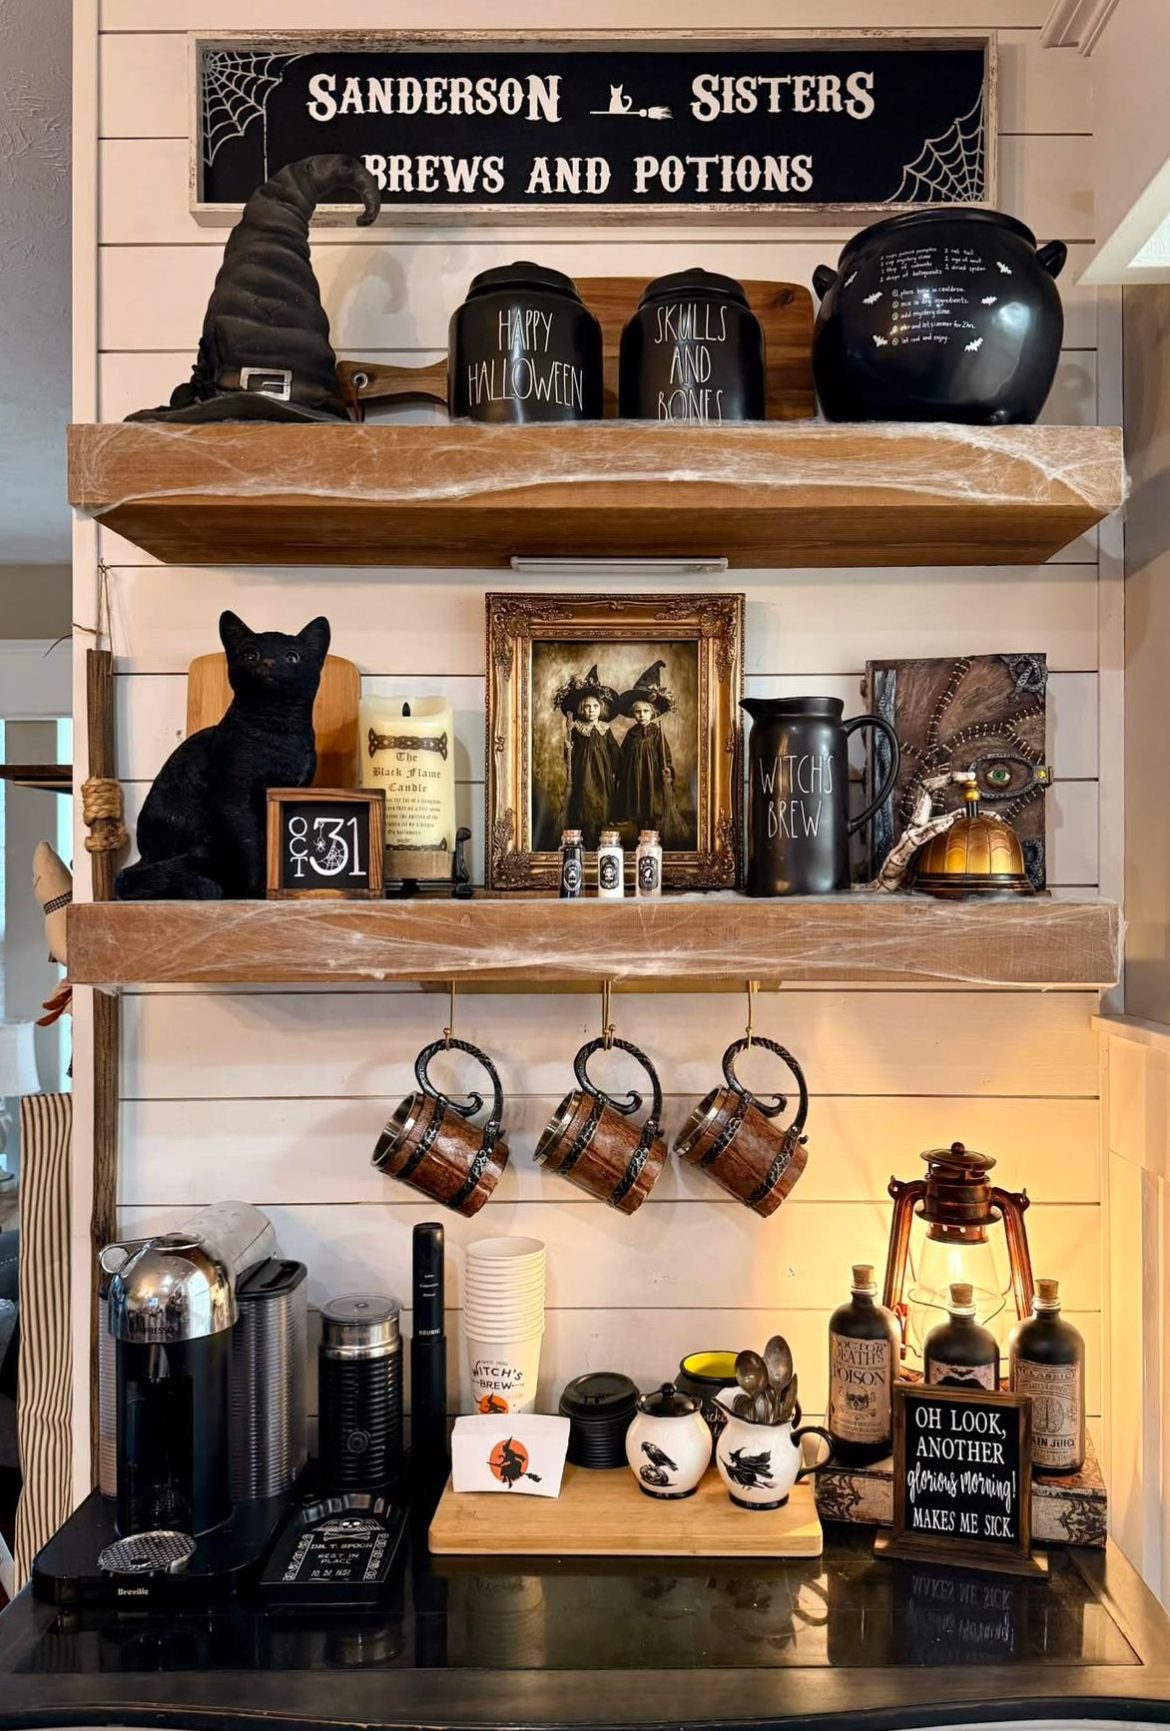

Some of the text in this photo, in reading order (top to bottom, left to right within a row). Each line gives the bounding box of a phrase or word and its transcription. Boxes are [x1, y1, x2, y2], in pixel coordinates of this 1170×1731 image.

[305, 72, 875, 123] SANDERSON SISTERS
[361, 154, 814, 194] BREWS AND POTIONS
[498, 309, 553, 353] HAPPY
[654, 303, 728, 344] SKULLS
[669, 344, 712, 386] AND
[468, 357, 583, 412] HALLOWEEN
[657, 389, 723, 426] BONES
[372, 766, 441, 779] Black Flame
[395, 751, 418, 763] The
[388, 781, 428, 793] Candle
[767, 800, 822, 838] BREW
[288, 816, 367, 877] OCT 31
[472, 1360, 523, 1381] WITCH'S
[480, 1380, 513, 1391] BREW
[832, 1363, 886, 1386] POISON
[915, 1406, 943, 1430] OH
[950, 1409, 1007, 1440] LOOK,
[916, 1436, 1005, 1465] ANOTHER
[906, 1460, 958, 1504] glorious
[913, 1507, 1015, 1538] MAKES ME SICK.
[118, 1587, 149, 1596] Breville
